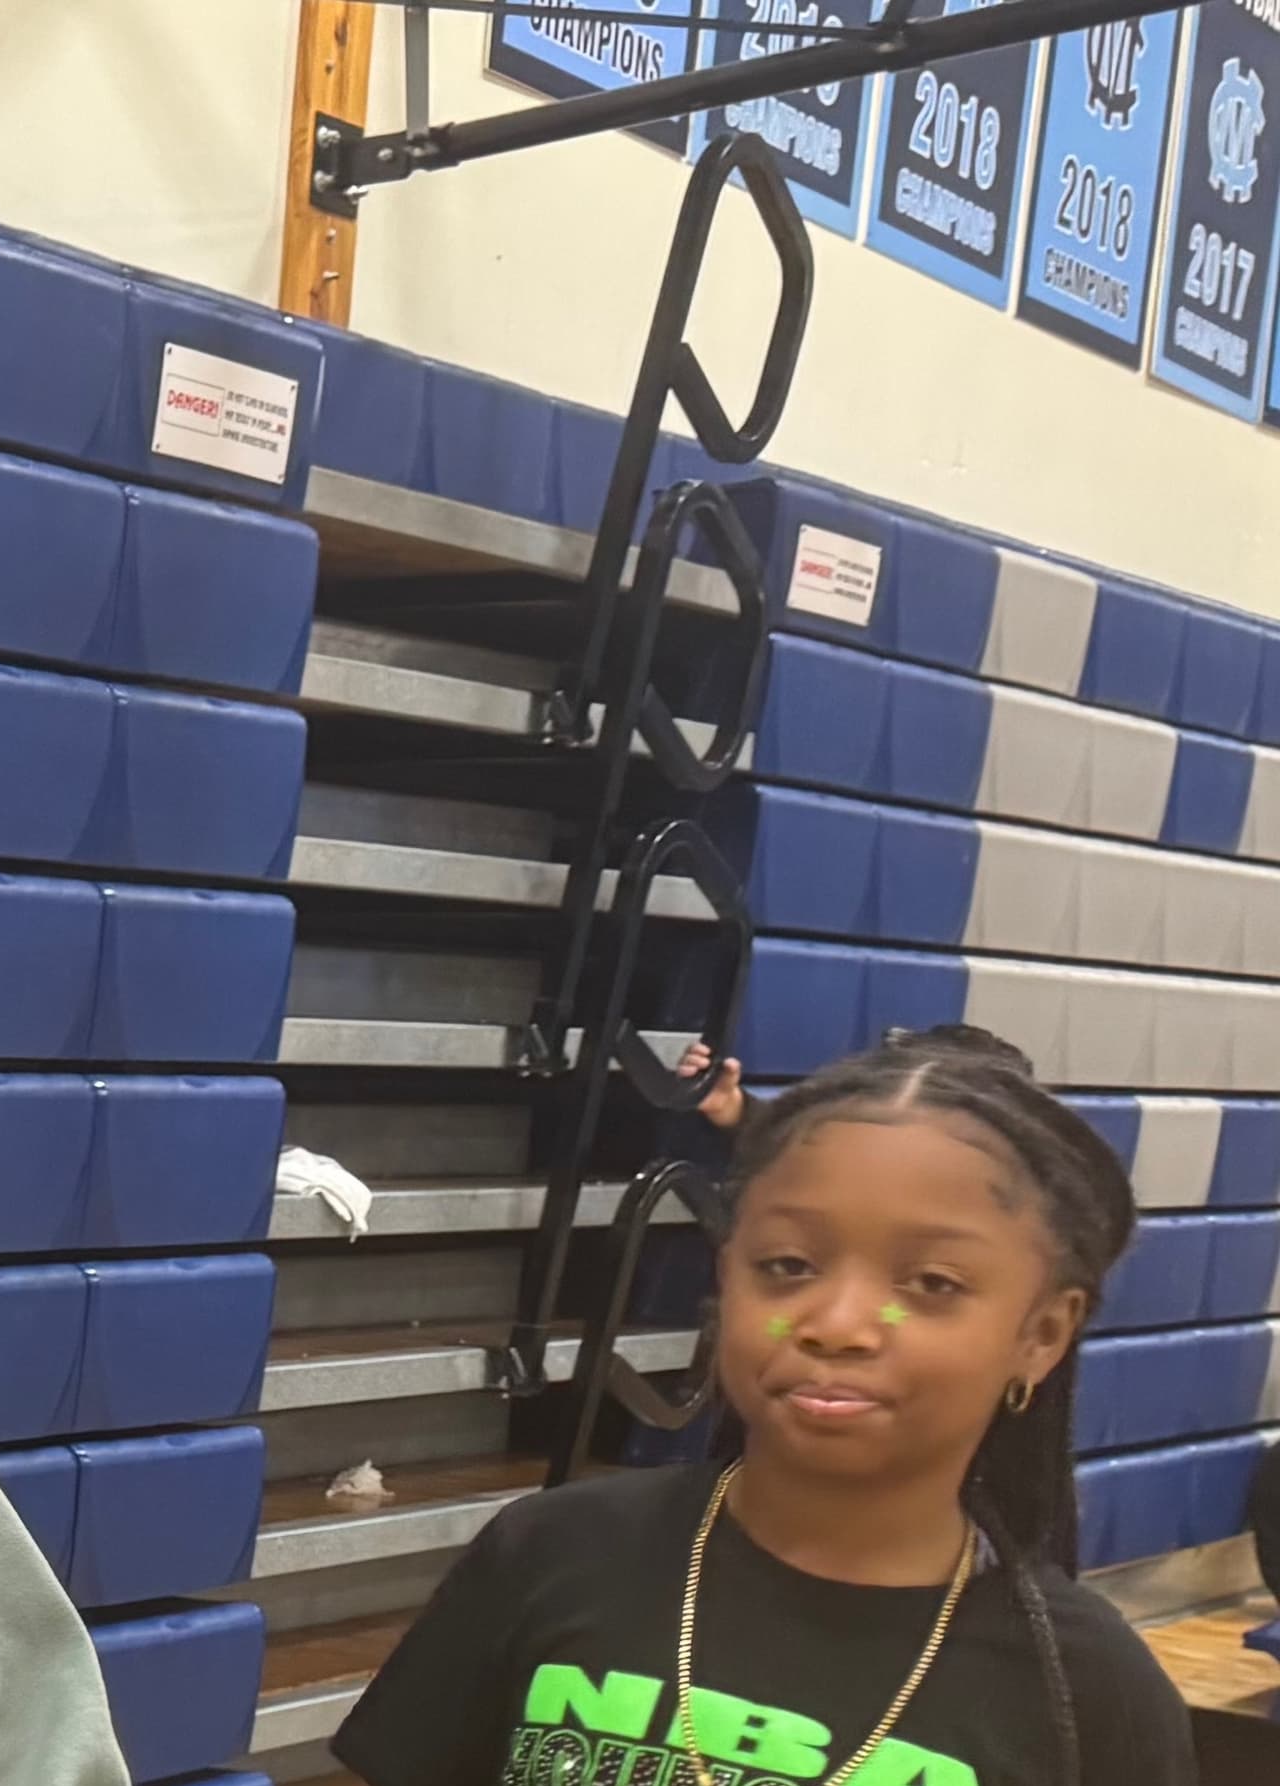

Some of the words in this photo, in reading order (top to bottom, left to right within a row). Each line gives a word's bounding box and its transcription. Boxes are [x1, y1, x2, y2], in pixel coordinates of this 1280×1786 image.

[908, 70, 1001, 191] 2018
[1054, 153, 1134, 262] 2018
[1183, 222, 1256, 321] 2017
